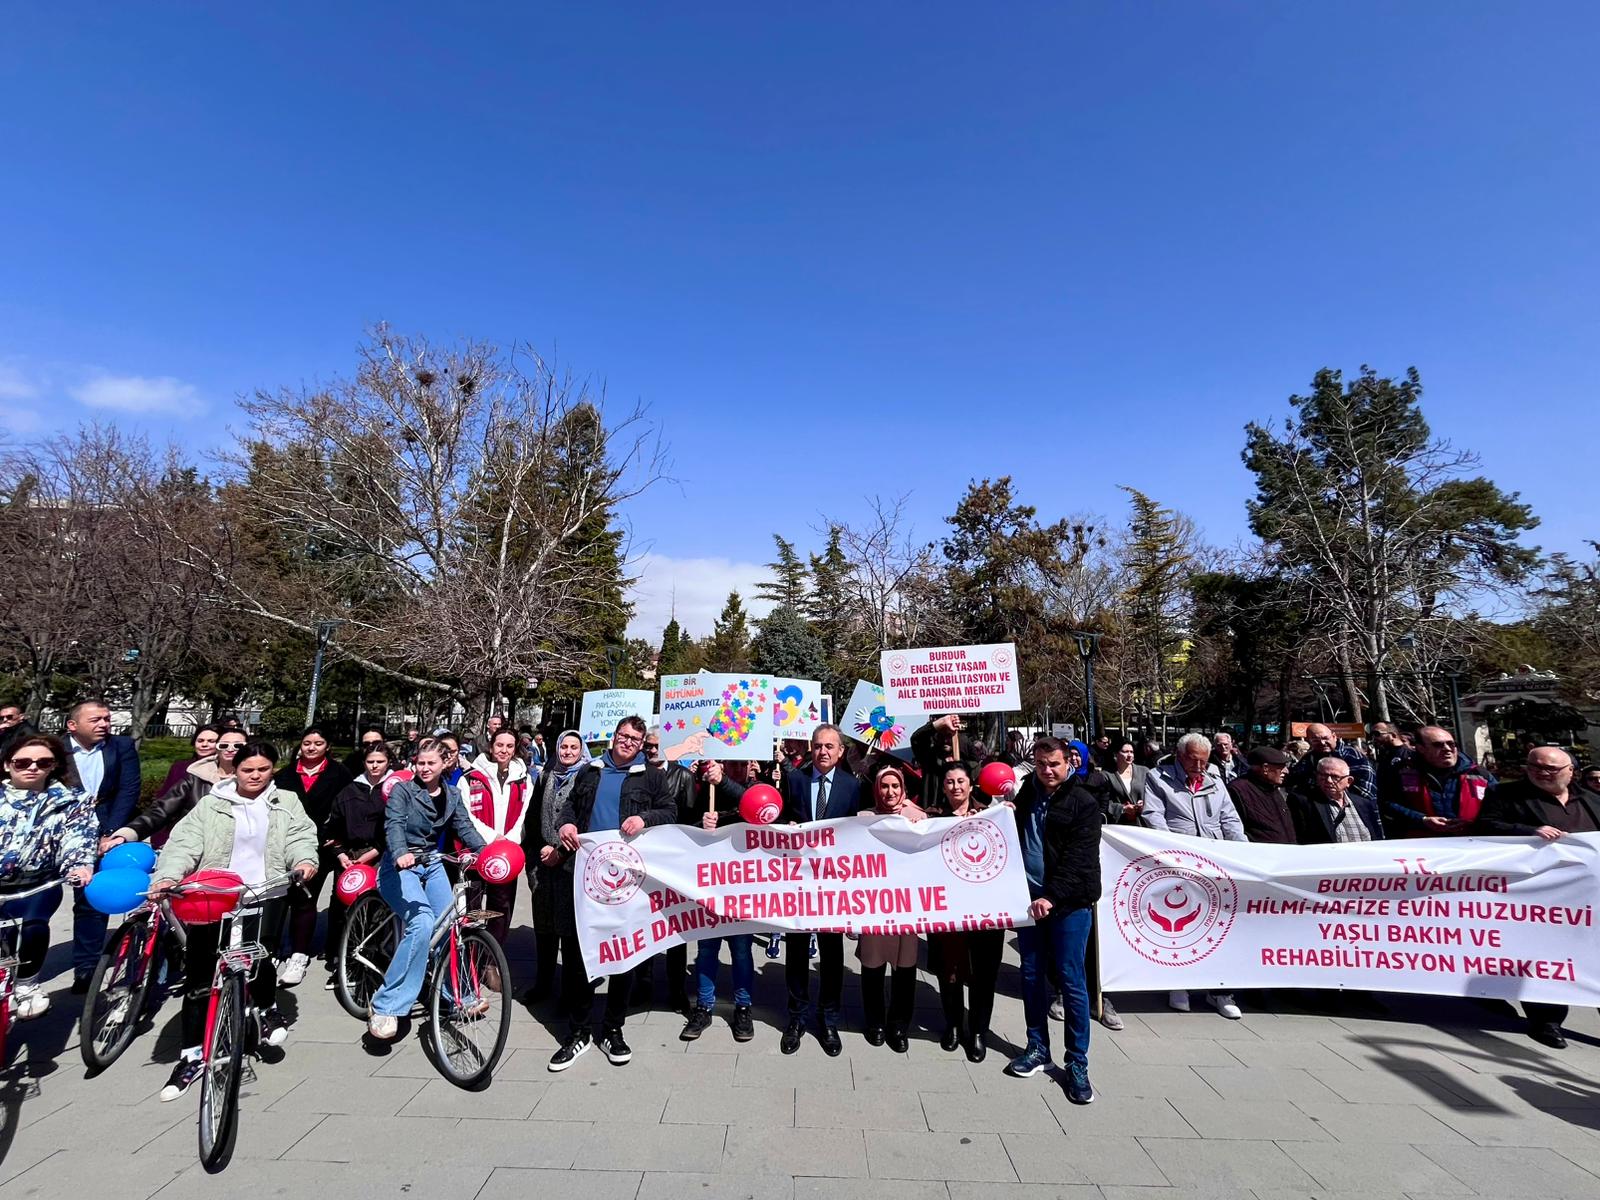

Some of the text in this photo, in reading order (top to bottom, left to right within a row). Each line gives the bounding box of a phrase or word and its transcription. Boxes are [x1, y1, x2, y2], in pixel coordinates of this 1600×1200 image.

[929, 650, 966, 662] BURDUR
[910, 661, 952, 675] ENGELSİZ
[955, 661, 987, 673] YAŞAM
[683, 676, 697, 686] BİR
[890, 671, 1011, 688] BAKIM REHABİLİTASYON VE
[898, 683, 1005, 699] AİLE DANIŞMA MERKEZİ
[664, 698, 721, 712] PARÇALARIYIZ
[923, 697, 981, 711] MÜDÜRLÜĞÜ
[745, 827, 836, 850] BURDUR
[697, 853, 887, 887] ENGELSİZ YAŞAM
[1318, 877, 1409, 893] BURDUR
[648, 886, 948, 919] BAM REHABİLİTASYON VE
[1246, 896, 1592, 927] HİLMİ-HAFİZE EVİN HUZUREVİ
[599, 929, 647, 964] AİLE
[651, 907, 747, 943] DANIŞ
[1318, 923, 1502, 948] YAŞLI BAKIM VE
[1261, 945, 1576, 982] REHABİLİTASYON MERKEZİ
